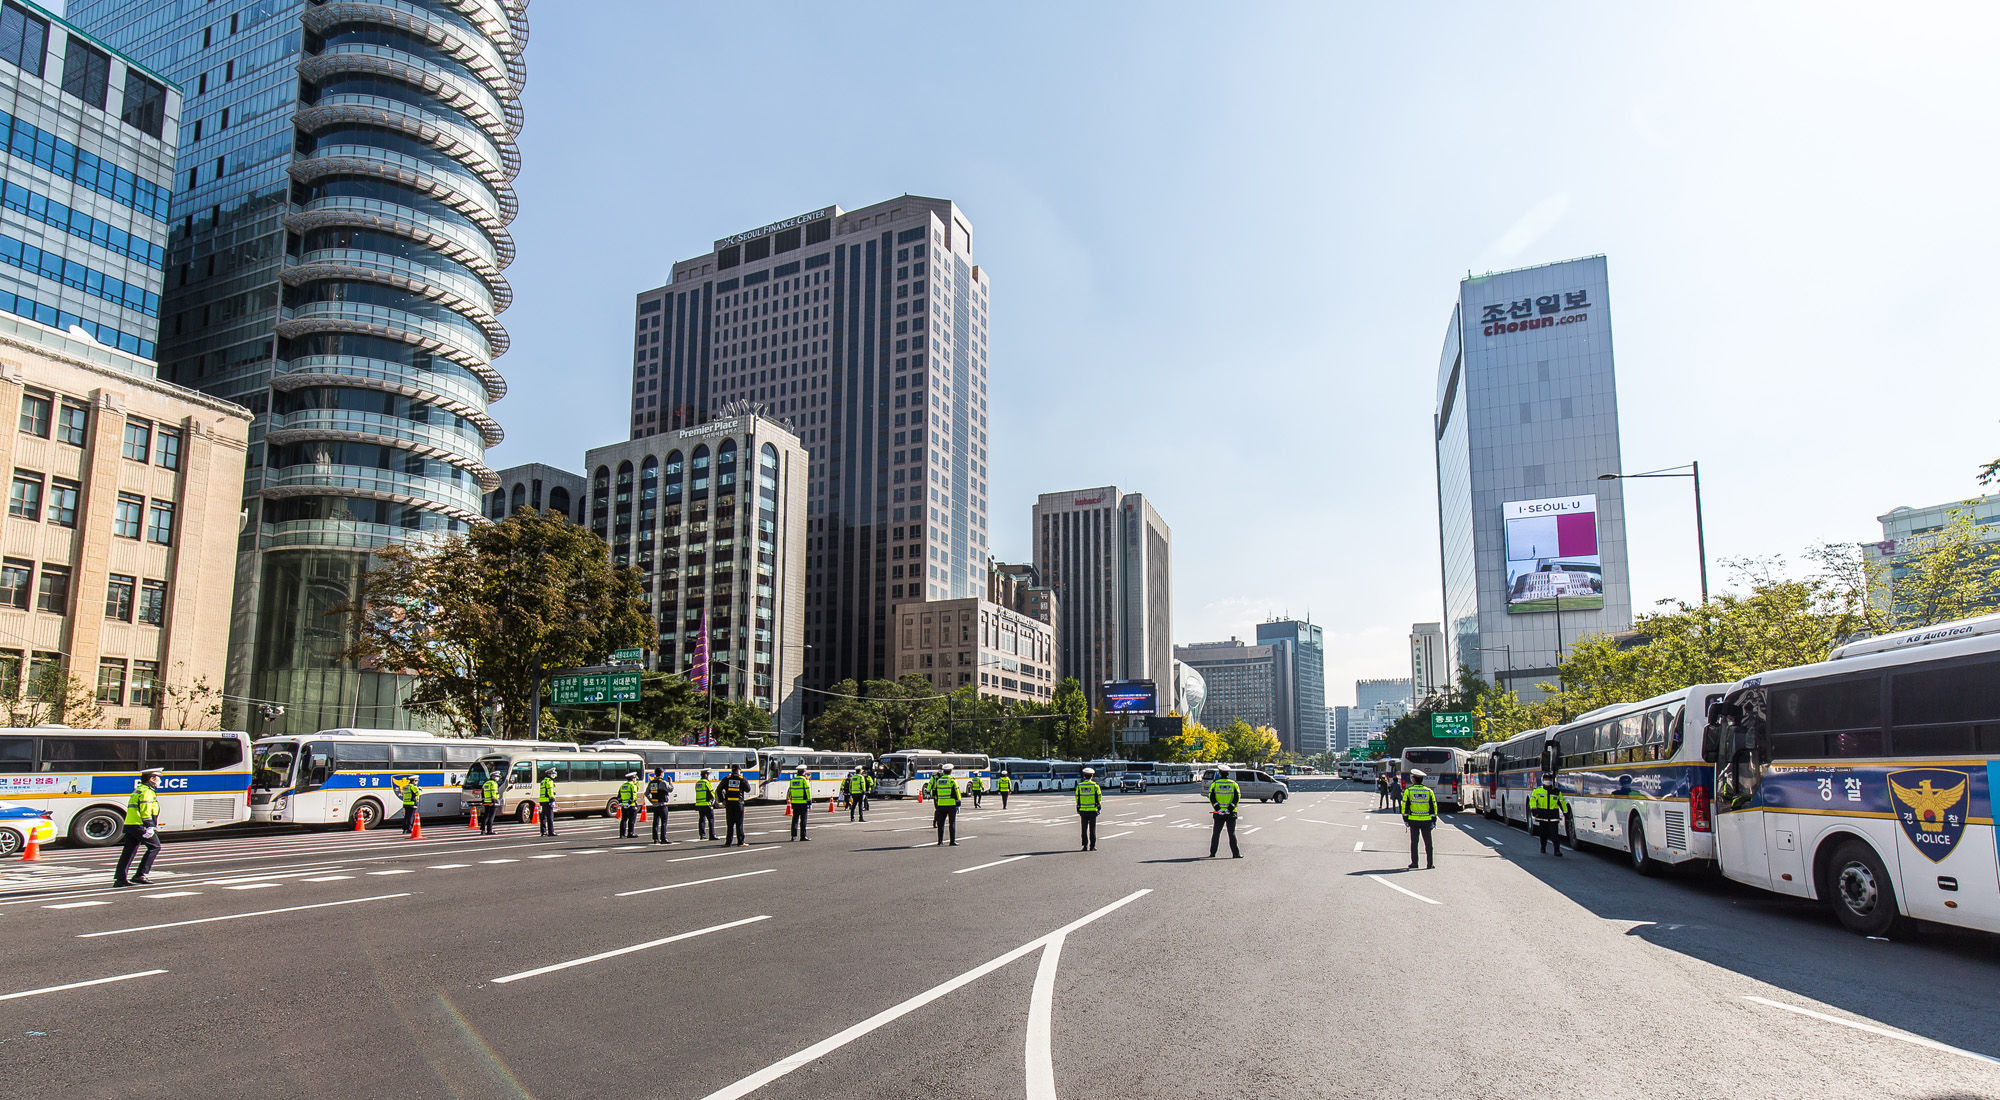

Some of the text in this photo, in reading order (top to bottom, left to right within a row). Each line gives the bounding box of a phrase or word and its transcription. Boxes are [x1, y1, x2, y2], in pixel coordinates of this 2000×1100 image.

[738, 229, 761, 242] SEOUL
[763, 219, 795, 234] FINANCE
[797, 210, 825, 224] CENTER
[1481, 290, 1592, 324] 조선일보
[1484, 313, 1588, 337] chosun.com
[680, 420, 738, 439] Premier Place
[1074, 496, 1102, 506] kobaco
[1906, 634, 1921, 643] KB
[583, 677, 606, 686] 종로1가
[613, 677, 637, 686] 서대문역
[1435, 715, 1468, 723] 종로1가
[1641, 774, 1662, 790] POLICE
[1916, 833, 1951, 845] POLICE
